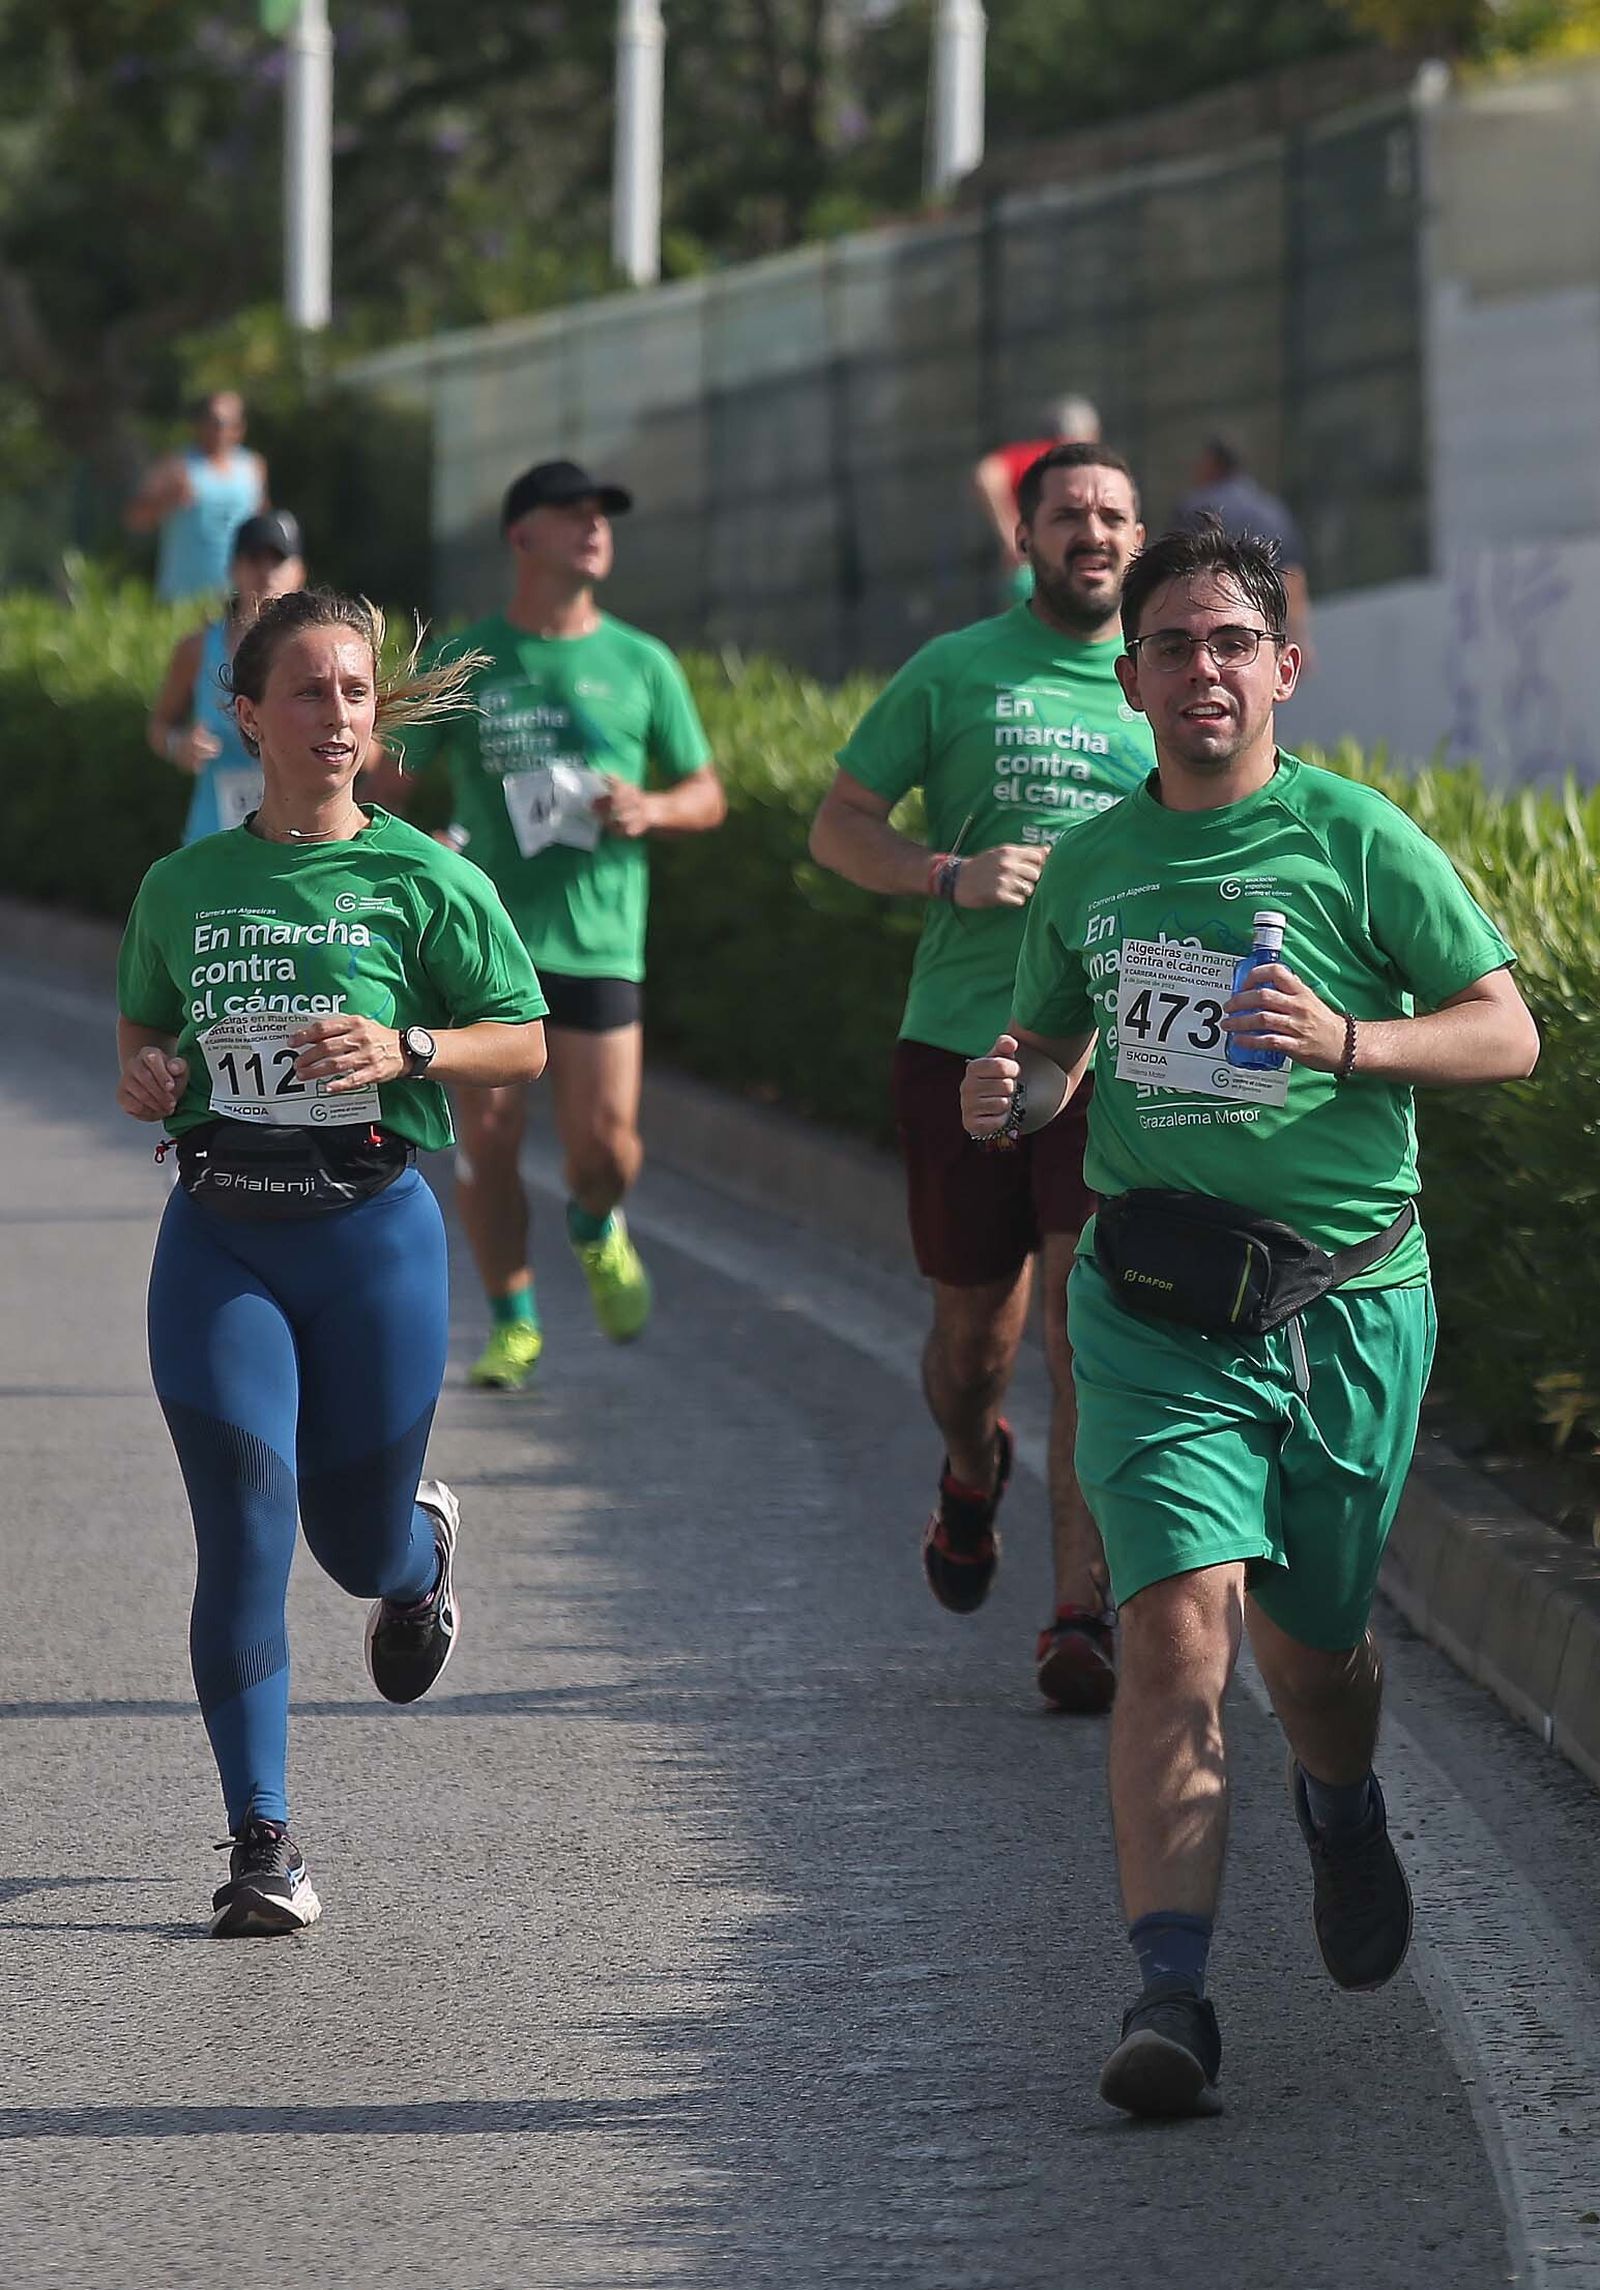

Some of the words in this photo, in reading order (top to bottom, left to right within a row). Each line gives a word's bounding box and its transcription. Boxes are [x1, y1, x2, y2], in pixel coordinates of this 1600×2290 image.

[995, 695, 1034, 718] En
[995, 724, 1109, 754] marcha
[995, 753, 1091, 781] contra
[993, 778, 1020, 802] el
[1025, 780, 1118, 812] cánce
[194, 923, 230, 955] En
[239, 918, 371, 948] marcha
[1083, 913, 1116, 947] En
[1126, 955, 1163, 968] contra
[1166, 959, 1177, 970] el
[1178, 961, 1221, 977] cáncer
[1127, 941, 1182, 958] Algeciras
[1184, 951, 1199, 961] en
[1202, 954, 1237, 968] march
[191, 953, 297, 988] contra
[1129, 968, 1157, 979] CARRERA
[1168, 974, 1195, 985] MARCHA
[1196, 979, 1223, 989] CONTRA
[190, 990, 218, 1023] el
[223, 987, 347, 1015] cáncer
[267, 1014, 309, 1023] marcha
[237, 1025, 247, 1034] el
[249, 1023, 288, 1033] cáncer
[1124, 989, 1223, 1049] 473
[1126, 1050, 1168, 1066] SKODA
[218, 1050, 306, 1097] 112
[1139, 1111, 1212, 1130] Grazalema
[1215, 1108, 1261, 1125] Motor
[234, 1173, 316, 1196] Kalenji
[1138, 1274, 1174, 1291] DAFOR
